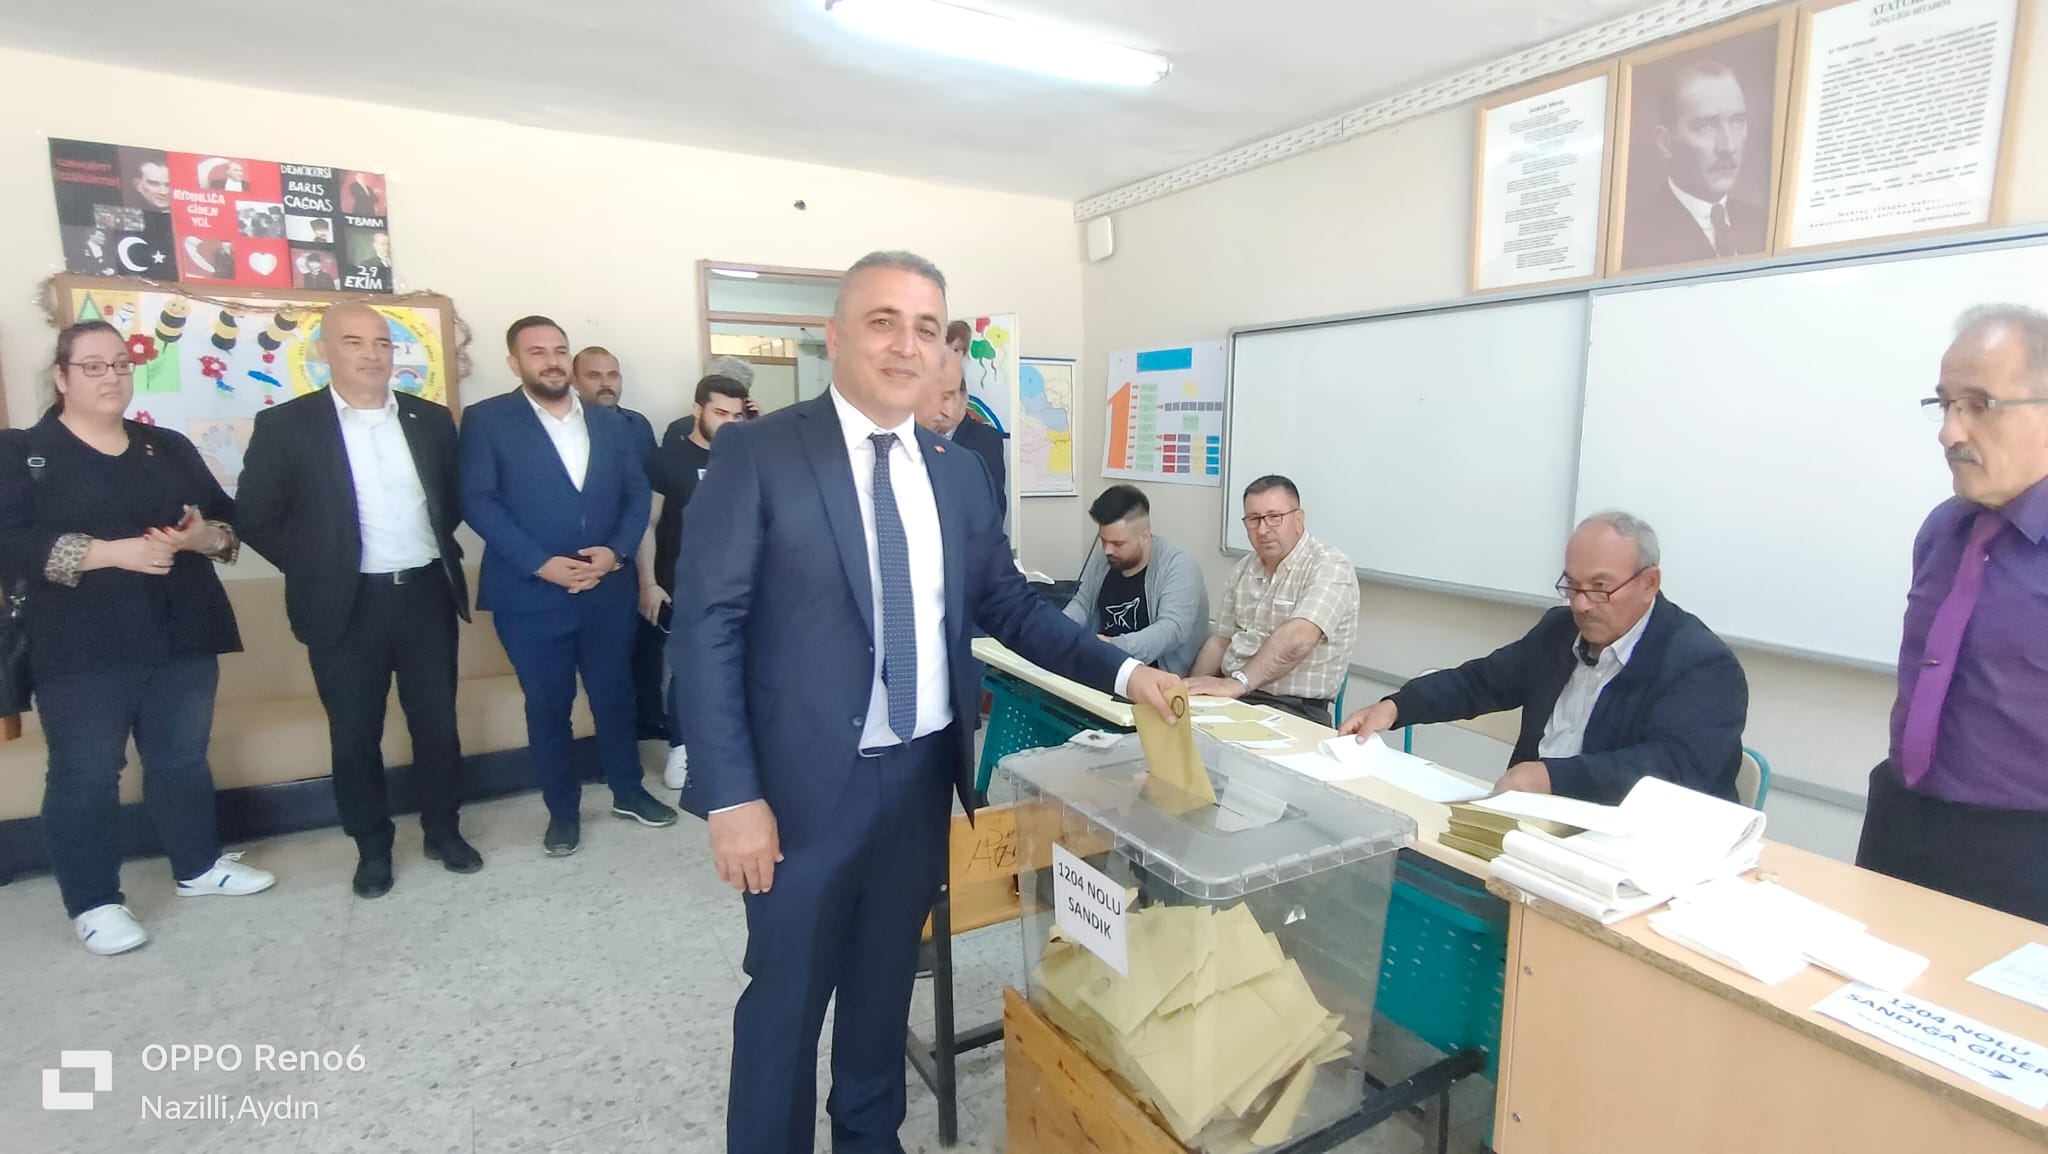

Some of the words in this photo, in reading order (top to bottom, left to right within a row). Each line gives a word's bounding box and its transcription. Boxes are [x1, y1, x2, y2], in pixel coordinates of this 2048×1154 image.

[1870, 0, 1924, 17] ATAT
[344, 215, 384, 228] TBMM
[344, 275, 383, 290] EKİM
[357, 265, 378, 278] 29
[1058, 861, 1084, 892] 1204
[1087, 881, 1121, 916] NOLU
[1068, 895, 1112, 941] SANDIK
[1846, 993, 1958, 1043] SANDIĞA
[1888, 998, 1947, 1024] 1204
[1953, 1024, 2031, 1056] NOLU
